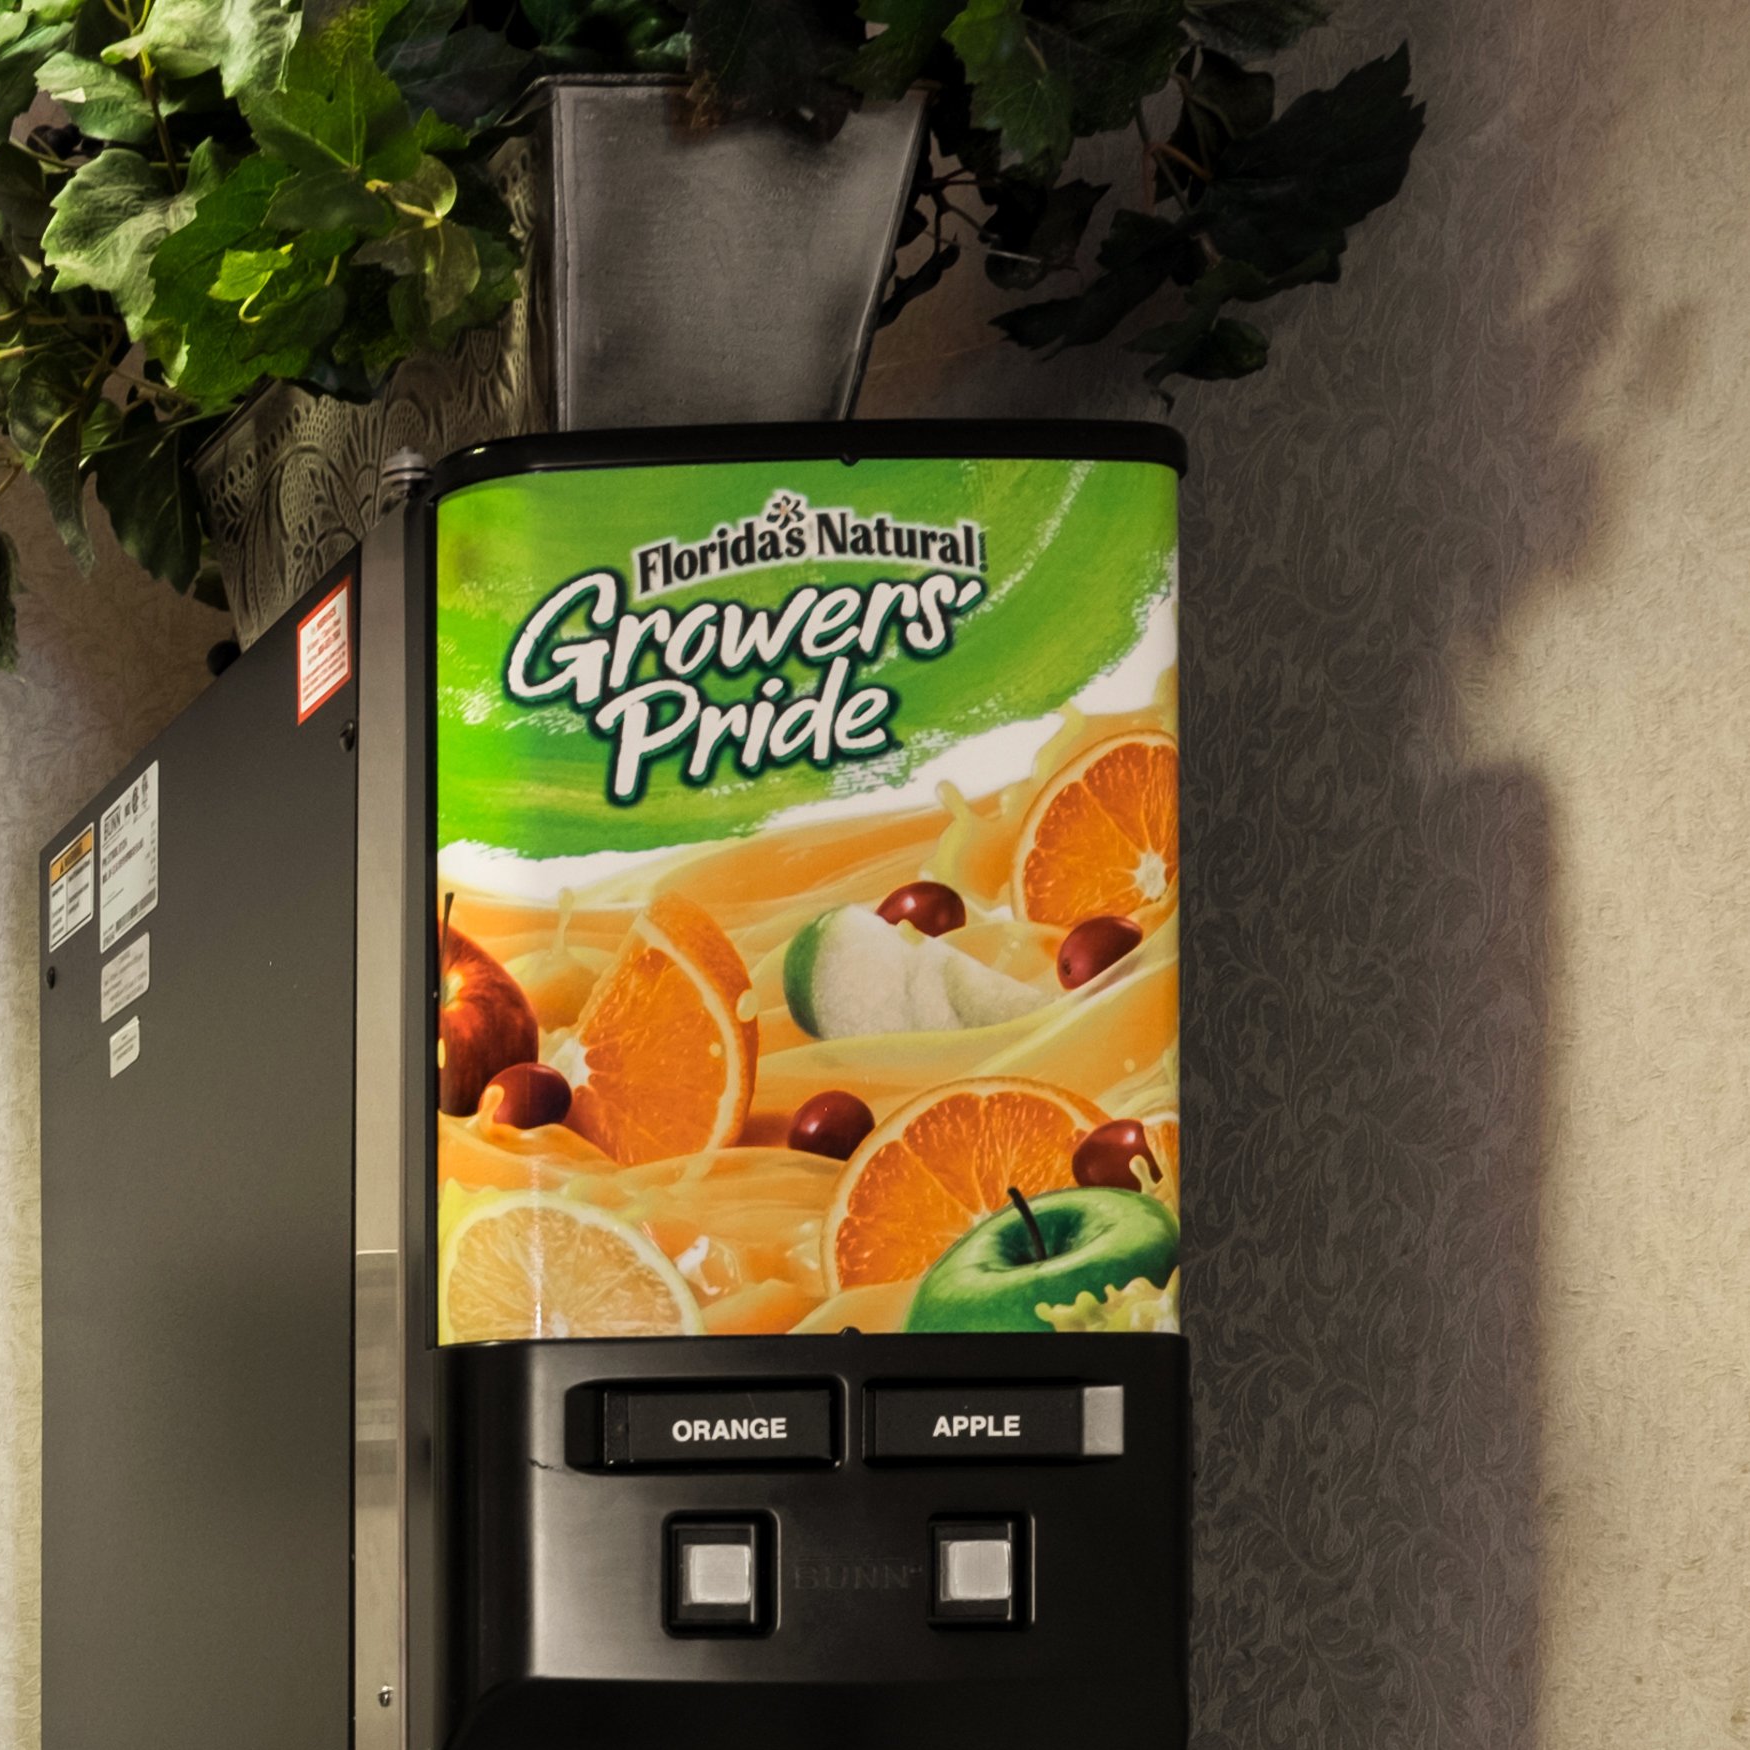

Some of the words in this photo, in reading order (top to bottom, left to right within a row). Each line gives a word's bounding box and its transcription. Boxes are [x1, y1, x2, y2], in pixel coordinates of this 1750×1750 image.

[816, 511, 976, 568] Natural
[594, 655, 892, 798] Pride
[671, 1417, 788, 1442] ORANGE
[932, 1415, 1022, 1438] APPLE
